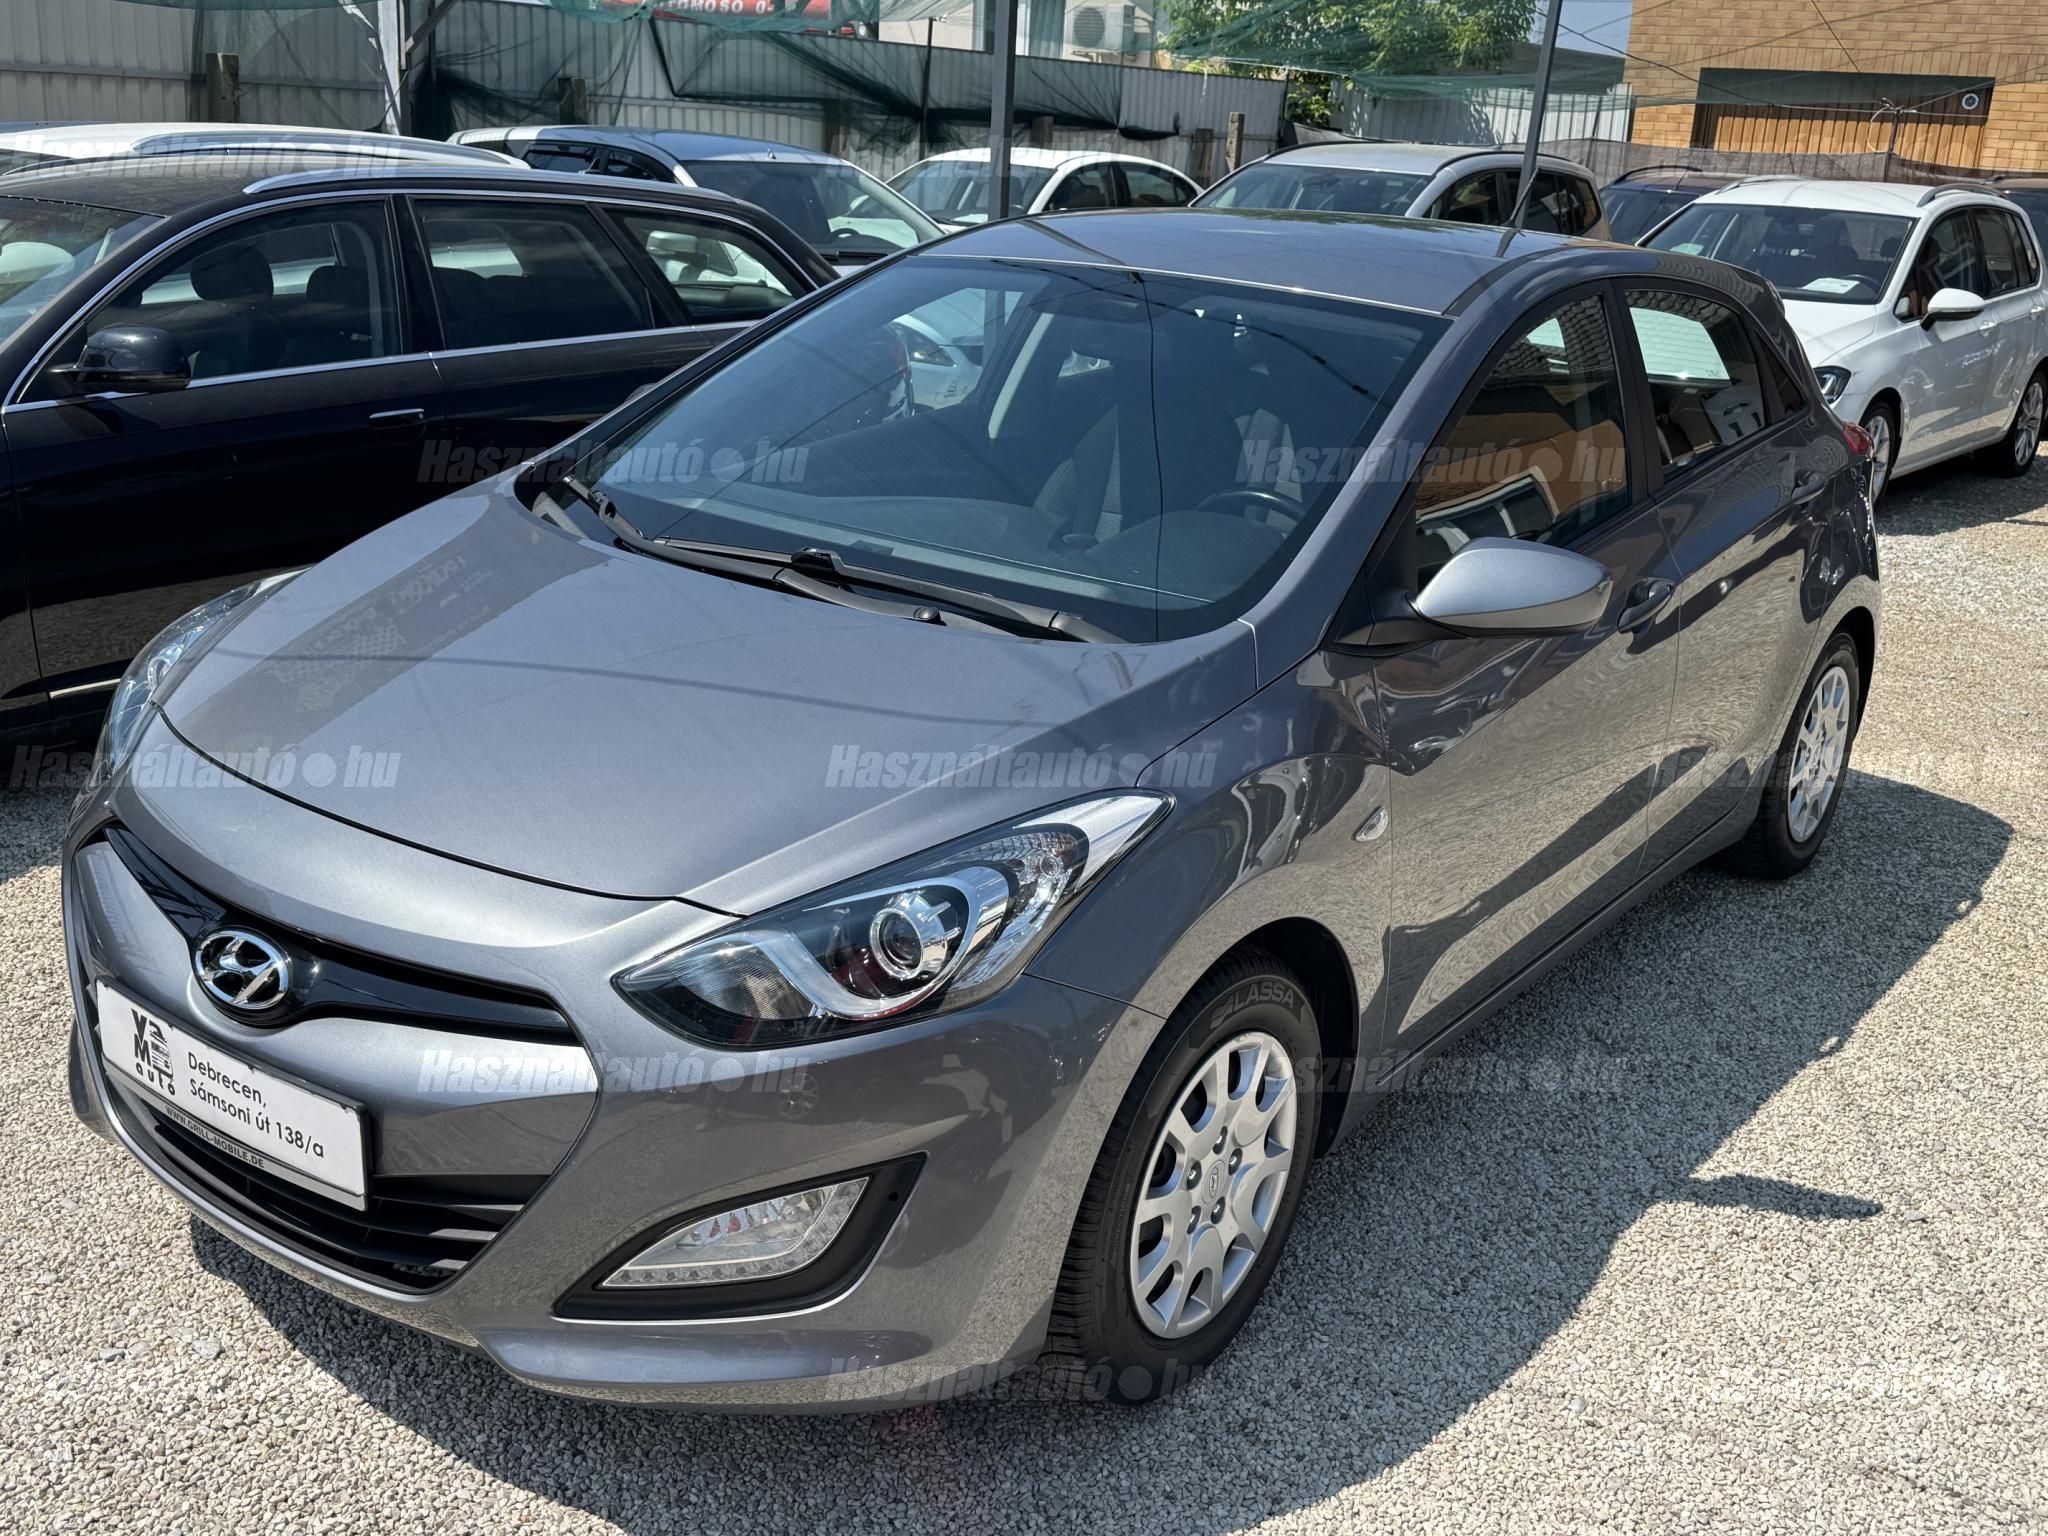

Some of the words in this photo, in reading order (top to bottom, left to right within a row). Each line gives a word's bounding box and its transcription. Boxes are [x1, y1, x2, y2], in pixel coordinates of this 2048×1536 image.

[1233, 981, 1295, 1011] LASSA
[188, 1051, 267, 1108] Debrecen,
[165, 1104, 265, 1169] WWW.GRILL-MOBILE.DE
[189, 1077, 251, 1125] Sámsoni
[255, 1112, 271, 1134] út
[275, 1121, 325, 1158] 138/a
